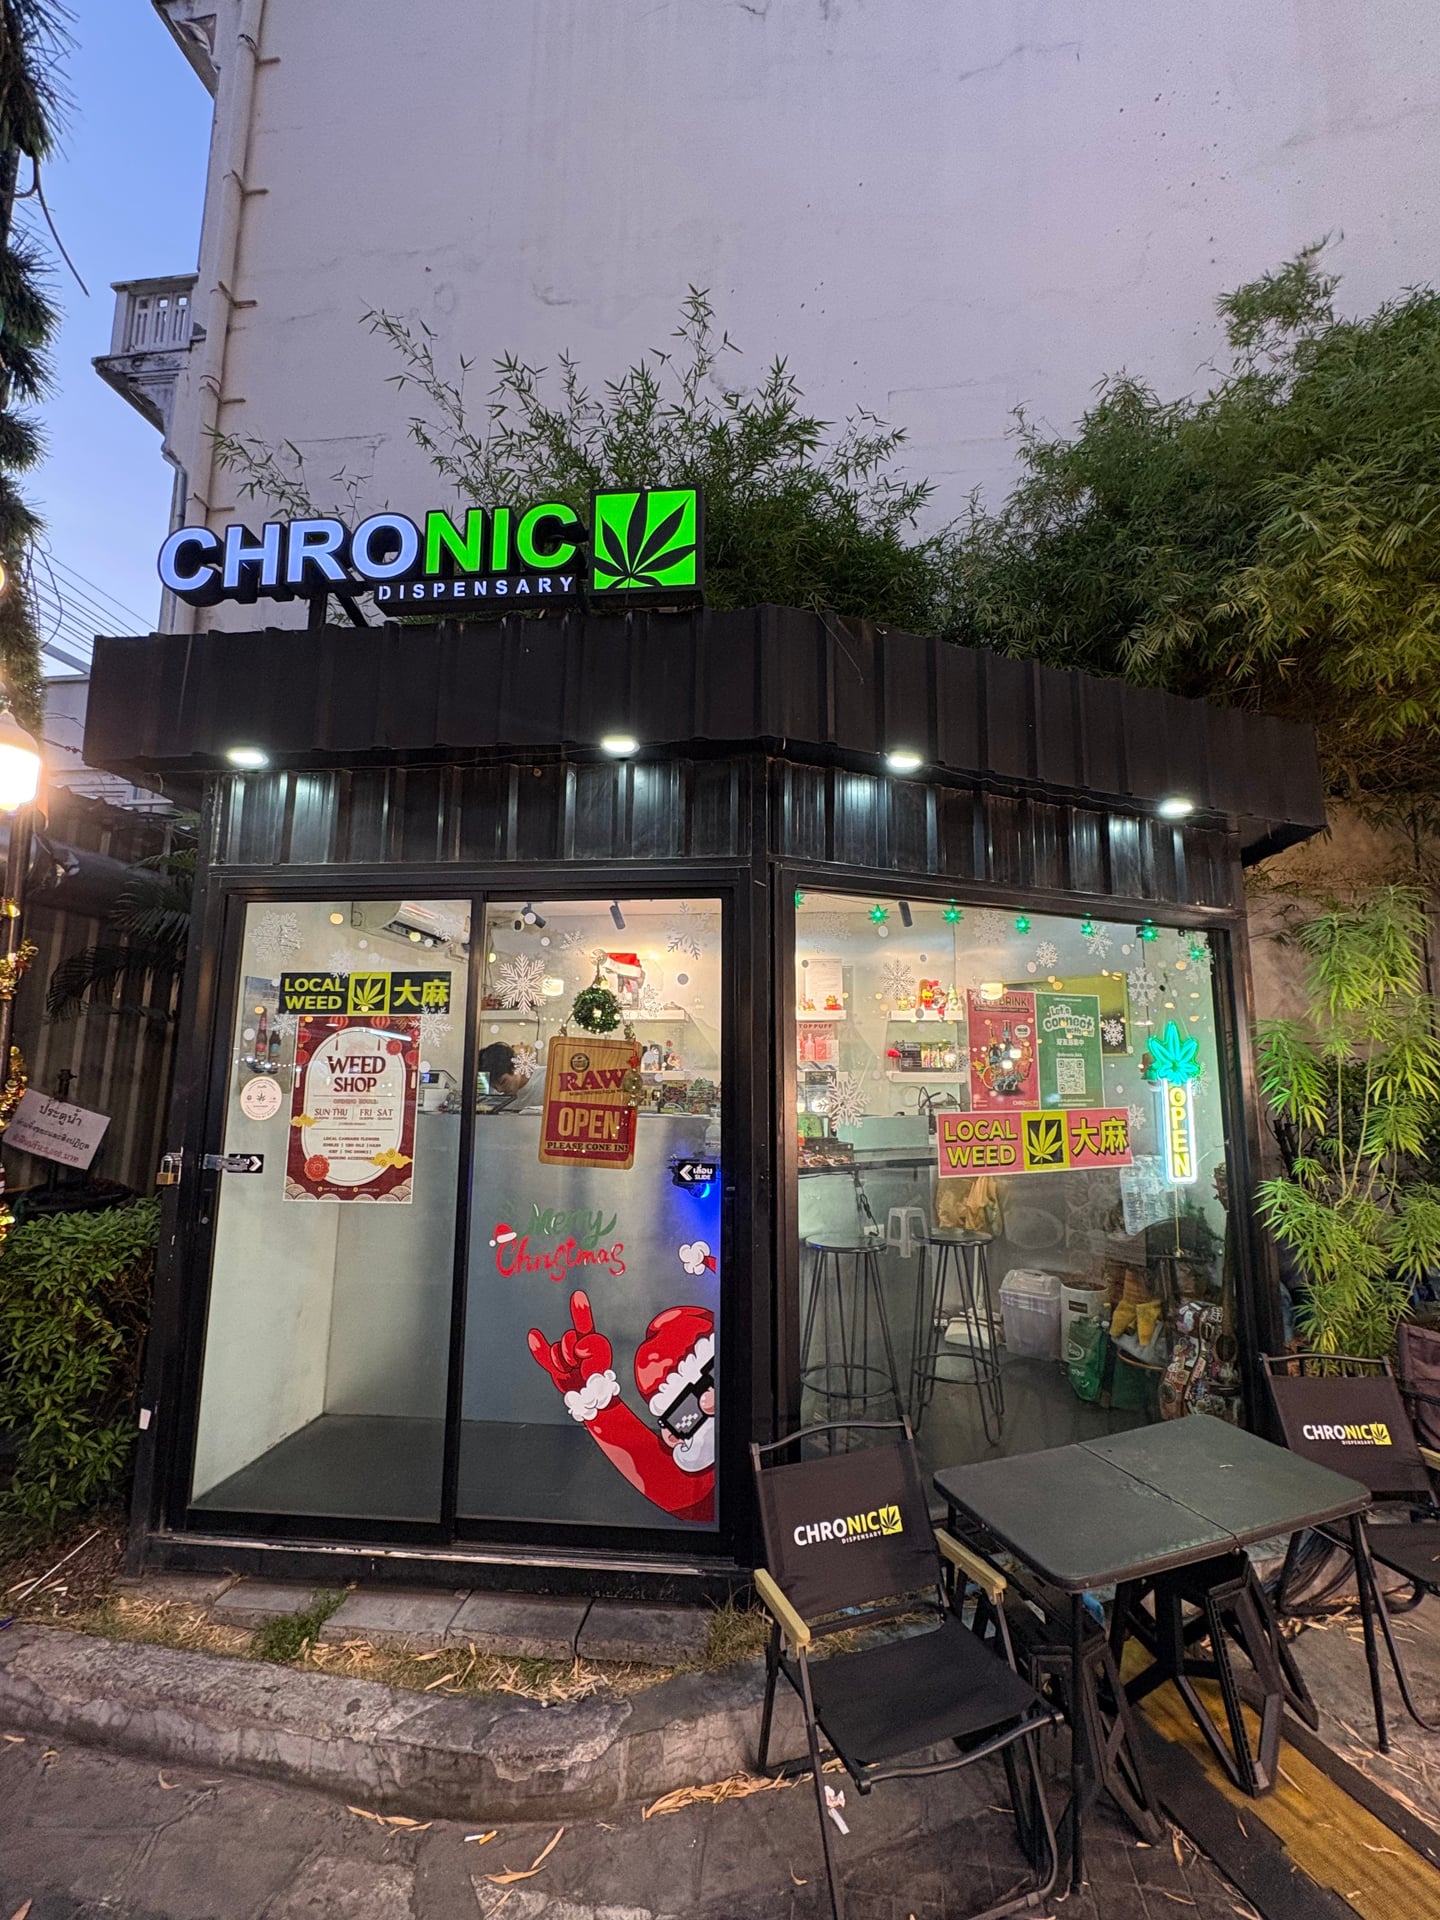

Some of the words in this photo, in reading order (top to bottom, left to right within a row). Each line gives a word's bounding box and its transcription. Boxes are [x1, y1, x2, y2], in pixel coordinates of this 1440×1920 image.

[159, 502, 580, 592] CHRONIC
[378, 577, 574, 601] DISPENSARY
[284, 977, 345, 992] LOCAL
[393, 979, 450, 1007] 大麻
[285, 995, 343, 1010] WEED
[326, 1055, 386, 1074] WEED
[333, 1077, 377, 1092] SHOP
[559, 1068, 628, 1092] RAW
[558, 1107, 620, 1140] OPEN
[944, 1120, 1017, 1142] LOCAL
[1169, 1086, 1191, 1177] OPEN
[547, 1142, 582, 1150] PLEASE
[583, 1143, 612, 1151] CONE
[614, 1144, 629, 1152] IN!
[1071, 1117, 1129, 1156] 大麻
[947, 1144, 1016, 1167] WEED
[512, 1202, 618, 1249] Merry
[495, 1232, 627, 1284] Christmas
[1303, 1424, 1373, 1440] CHRONIC
[793, 1511, 880, 1546] CHRONIC
[841, 1530, 881, 1544] DISPENSARY
